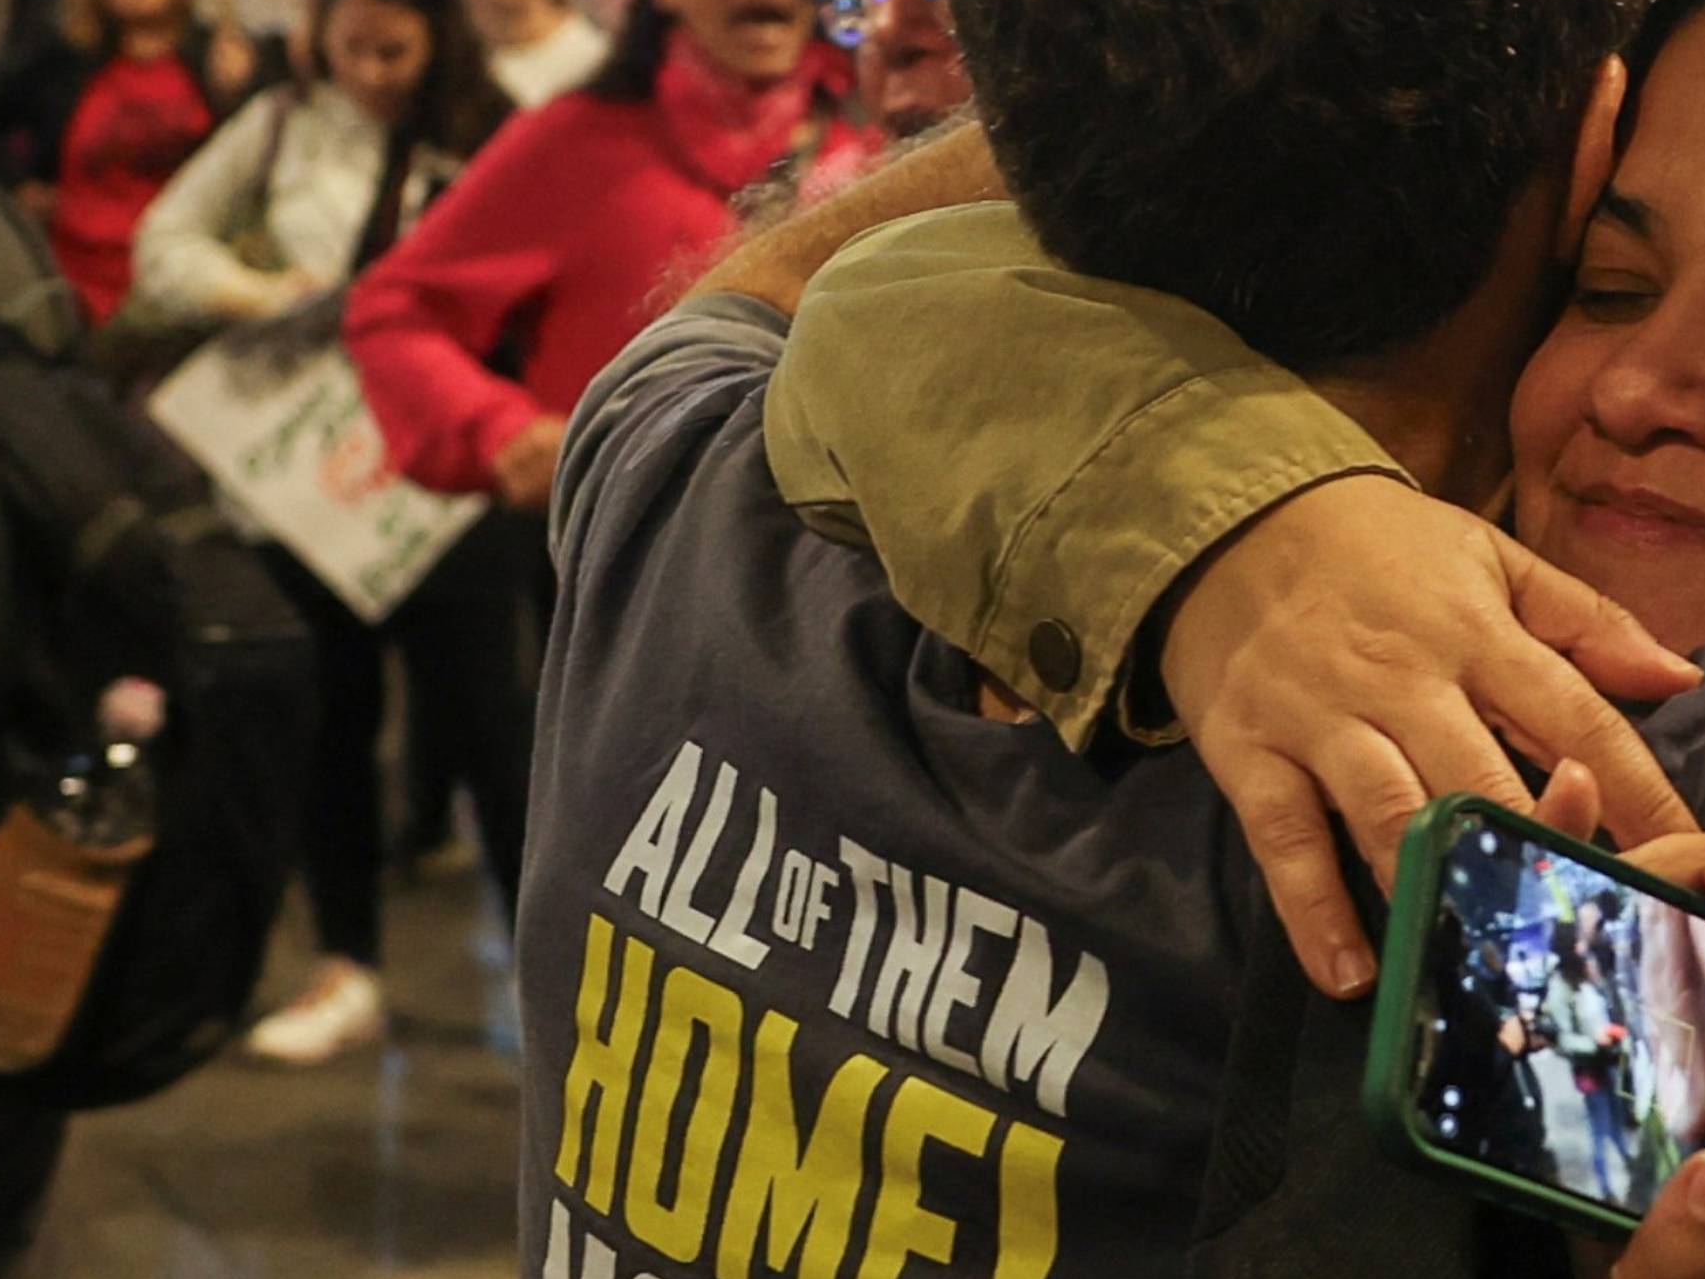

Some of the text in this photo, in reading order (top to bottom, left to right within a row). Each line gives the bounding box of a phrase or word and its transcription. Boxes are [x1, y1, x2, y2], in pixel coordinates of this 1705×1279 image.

[603, 740, 1111, 1118] ALL OF THEM
